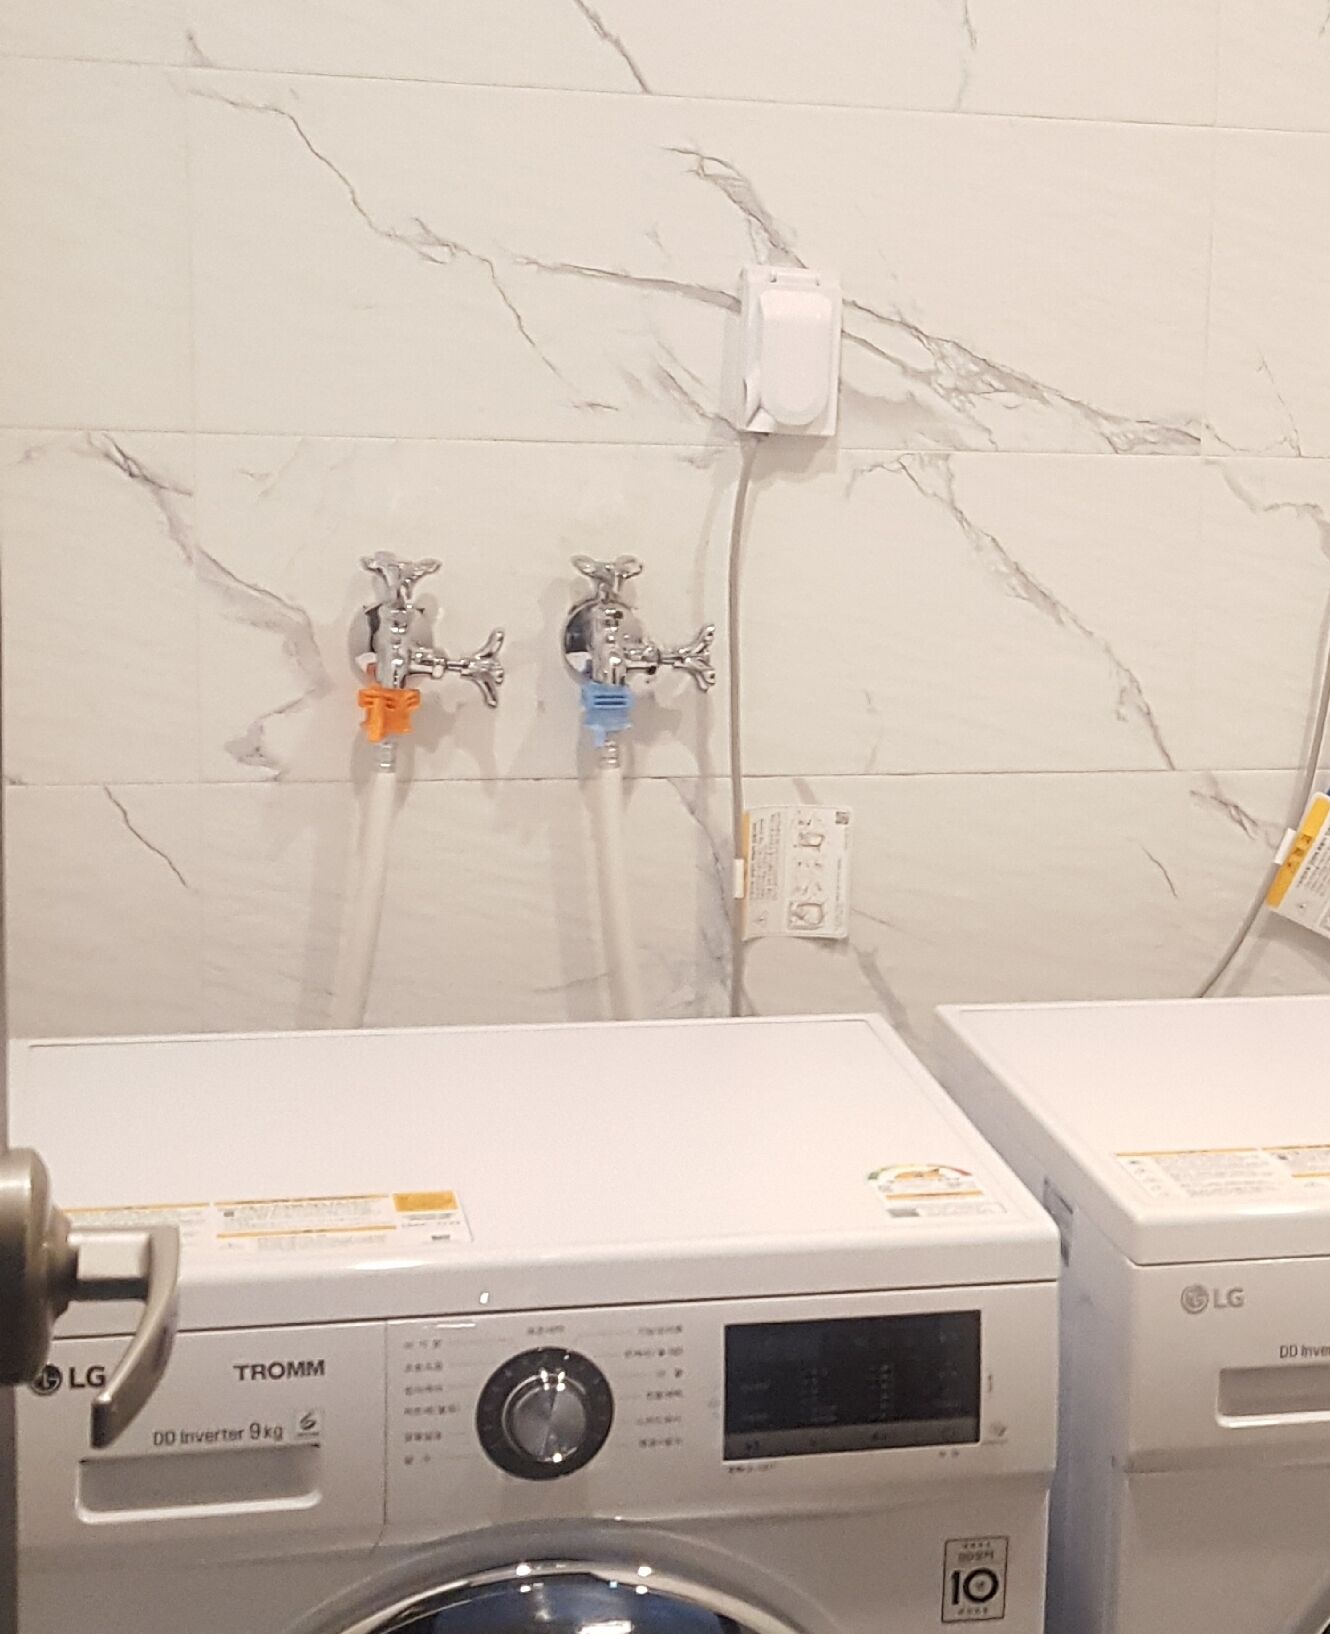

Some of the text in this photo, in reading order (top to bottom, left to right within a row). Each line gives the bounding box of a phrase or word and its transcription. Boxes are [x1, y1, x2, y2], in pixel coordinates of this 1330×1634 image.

[1213, 1288, 1245, 1309] LG
[1279, 1344, 1298, 1359] DD
[69, 1366, 106, 1389] LG
[232, 1359, 325, 1381] TROMM
[153, 1431, 176, 1446] DD
[180, 1427, 243, 1445] Inverter
[951, 1567, 999, 1606] 10
